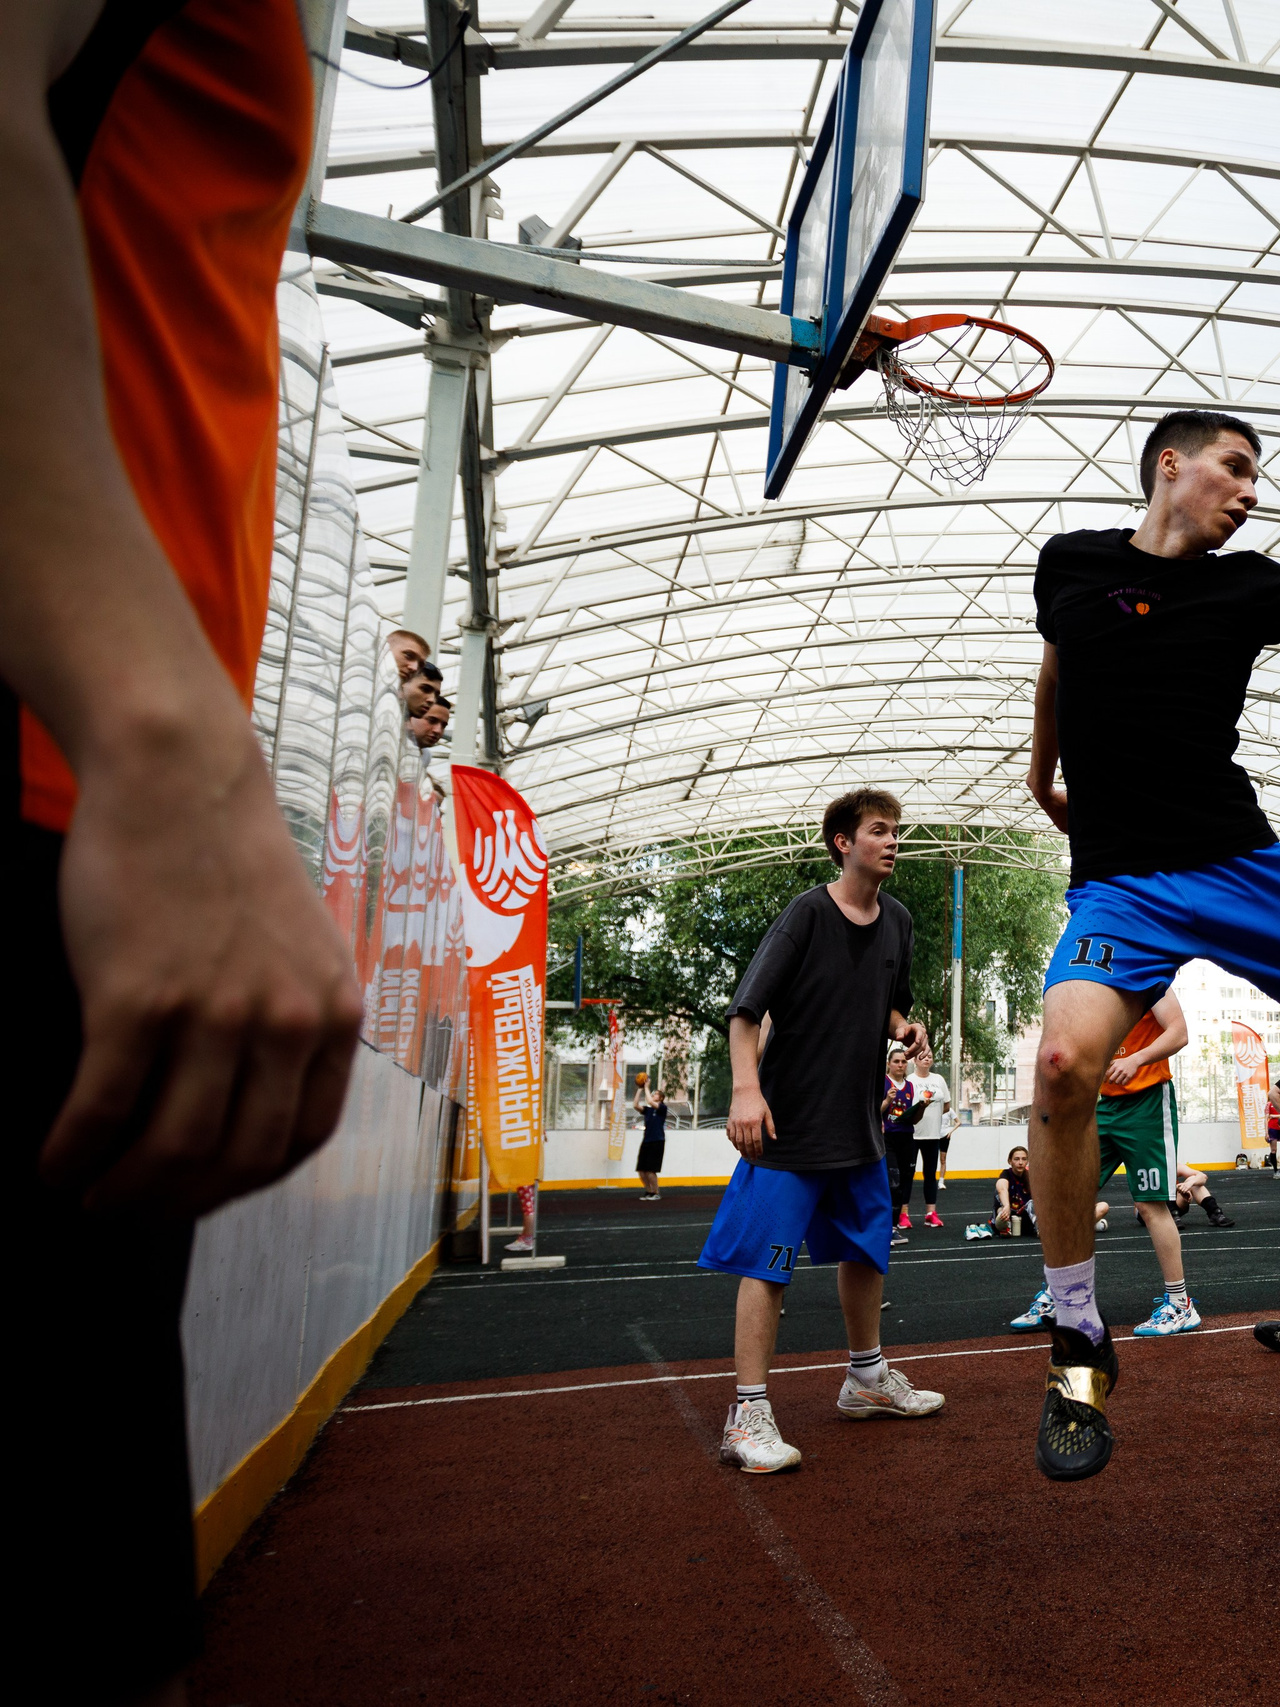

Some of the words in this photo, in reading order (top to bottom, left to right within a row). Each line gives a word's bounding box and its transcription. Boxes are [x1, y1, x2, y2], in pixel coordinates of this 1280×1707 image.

[1069, 938, 1115, 975] 11
[521, 977, 541, 1065] ОКРУЖНОЙ
[486, 974, 532, 1150] ОРАНЖЕВЫЙ
[1241, 1084, 1258, 1138] ОРАНЖЕВЫЙ
[1137, 1167, 1161, 1191] 30
[766, 1243, 794, 1272] 71
